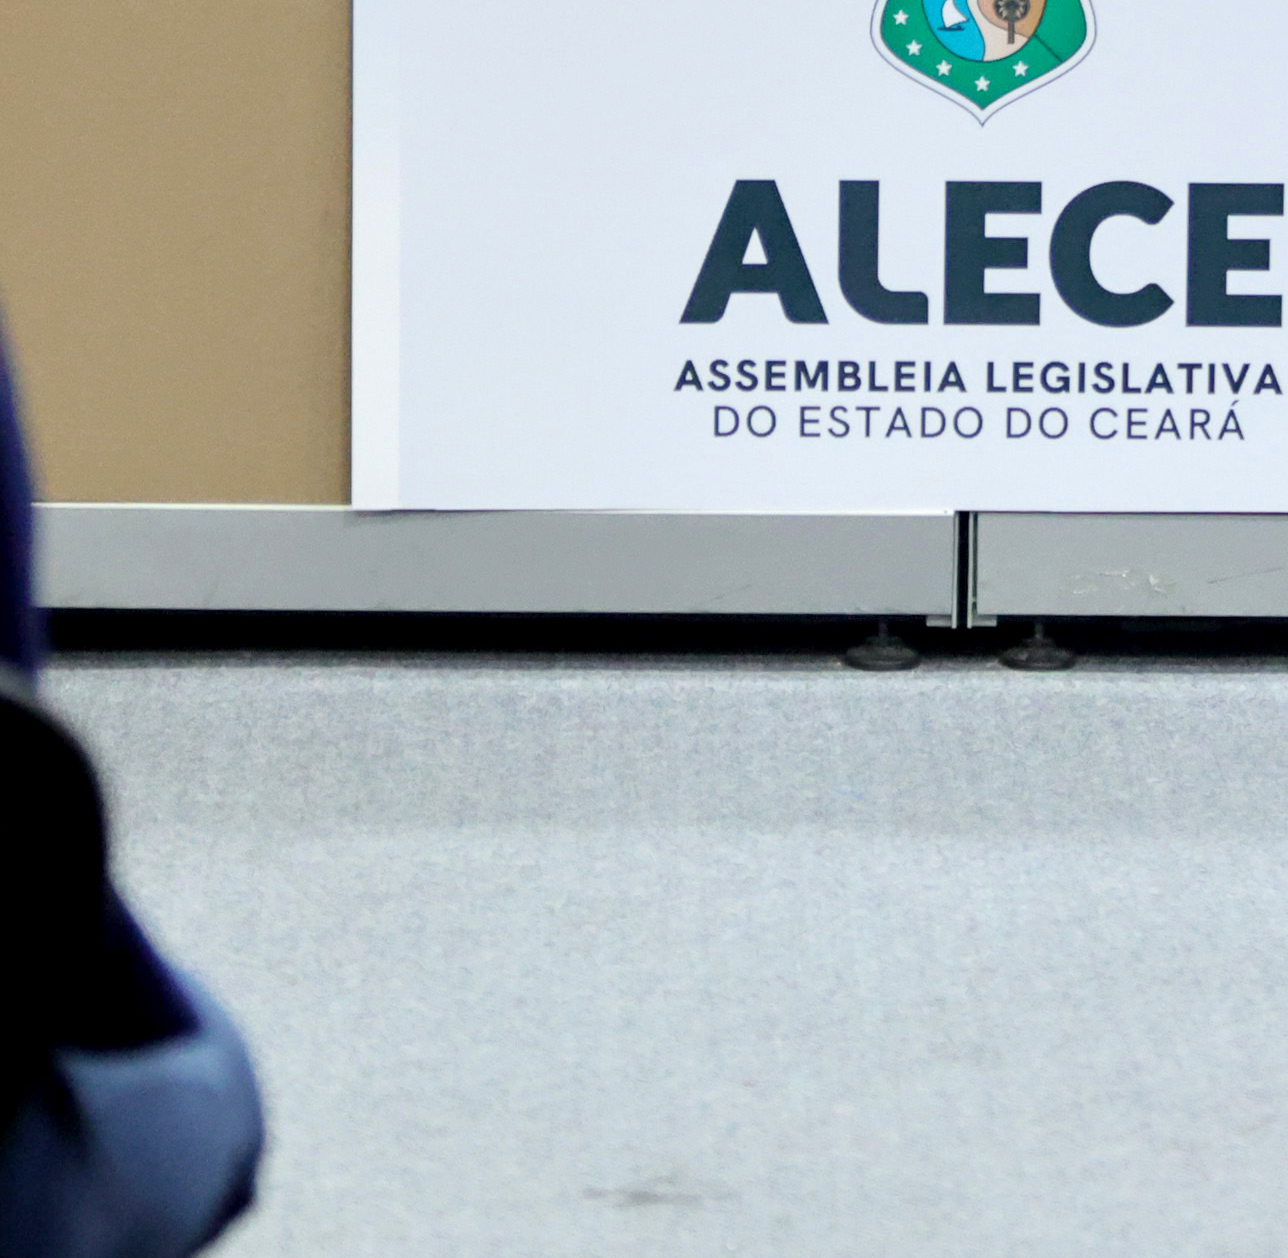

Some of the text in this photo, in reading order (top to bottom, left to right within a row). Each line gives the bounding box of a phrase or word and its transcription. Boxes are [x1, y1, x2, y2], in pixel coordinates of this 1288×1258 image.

[679, 179, 1285, 328] ALECE
[674, 359, 1283, 395] ASSEMBLEIA LEGISLATIVA
[713, 398, 1245, 441] DO ESTADO DO CEARÁ
